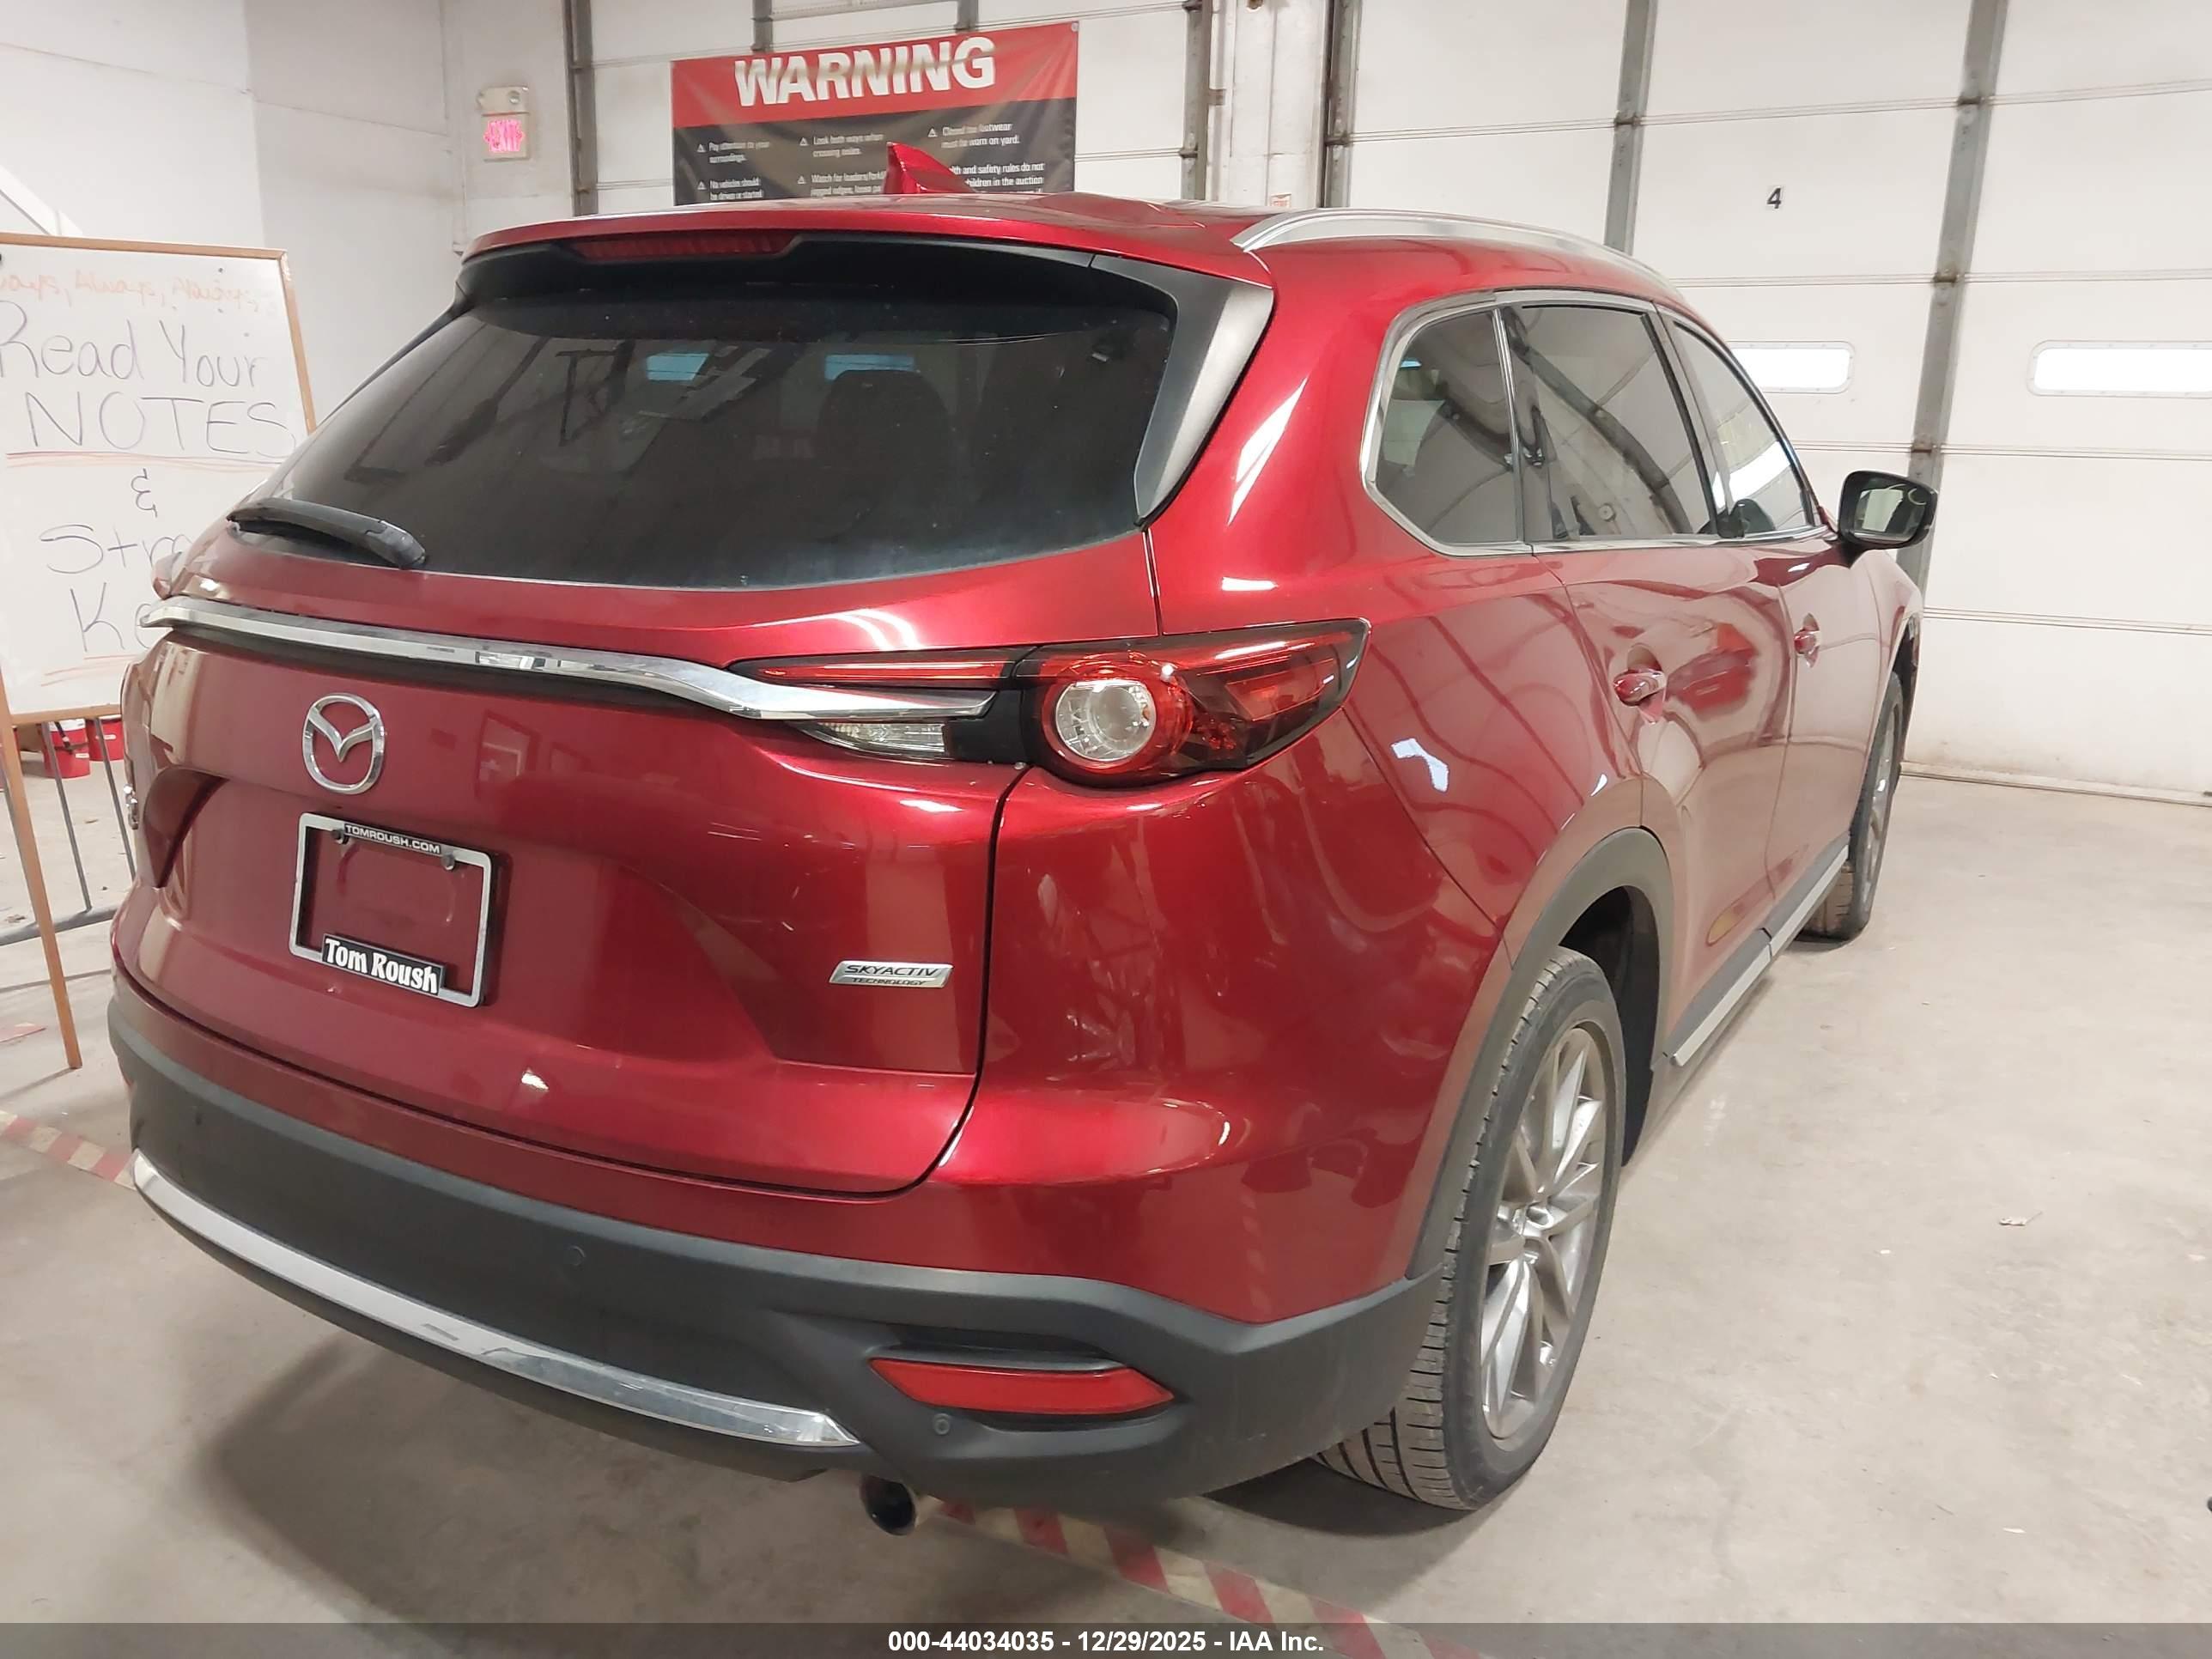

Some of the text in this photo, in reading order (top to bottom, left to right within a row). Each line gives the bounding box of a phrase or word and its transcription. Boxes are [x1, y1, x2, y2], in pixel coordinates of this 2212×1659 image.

[734, 36, 996, 106] WARNING
[969, 137, 988, 146] worn
[988, 137, 999, 145] on
[1000, 135, 1020, 146] yard.
[962, 165, 976, 174] and
[977, 163, 1001, 174] safety
[1002, 163, 1019, 173] rules
[1020, 161, 1030, 171] do
[1031, 161, 1045, 171] not
[968, 176, 1043, 187] hildren in the auction
[1766, 187, 1782, 210] 4
[0, 300, 267, 387] Read Your
[25, 391, 296, 459] NOTES
[345, 824, 441, 854] TOMROUSH.COM
[325, 937, 438, 994] Tom Roush
[844, 964, 939, 976] SKYACTIV
[851, 976, 927, 986] TECHNOLOGY
